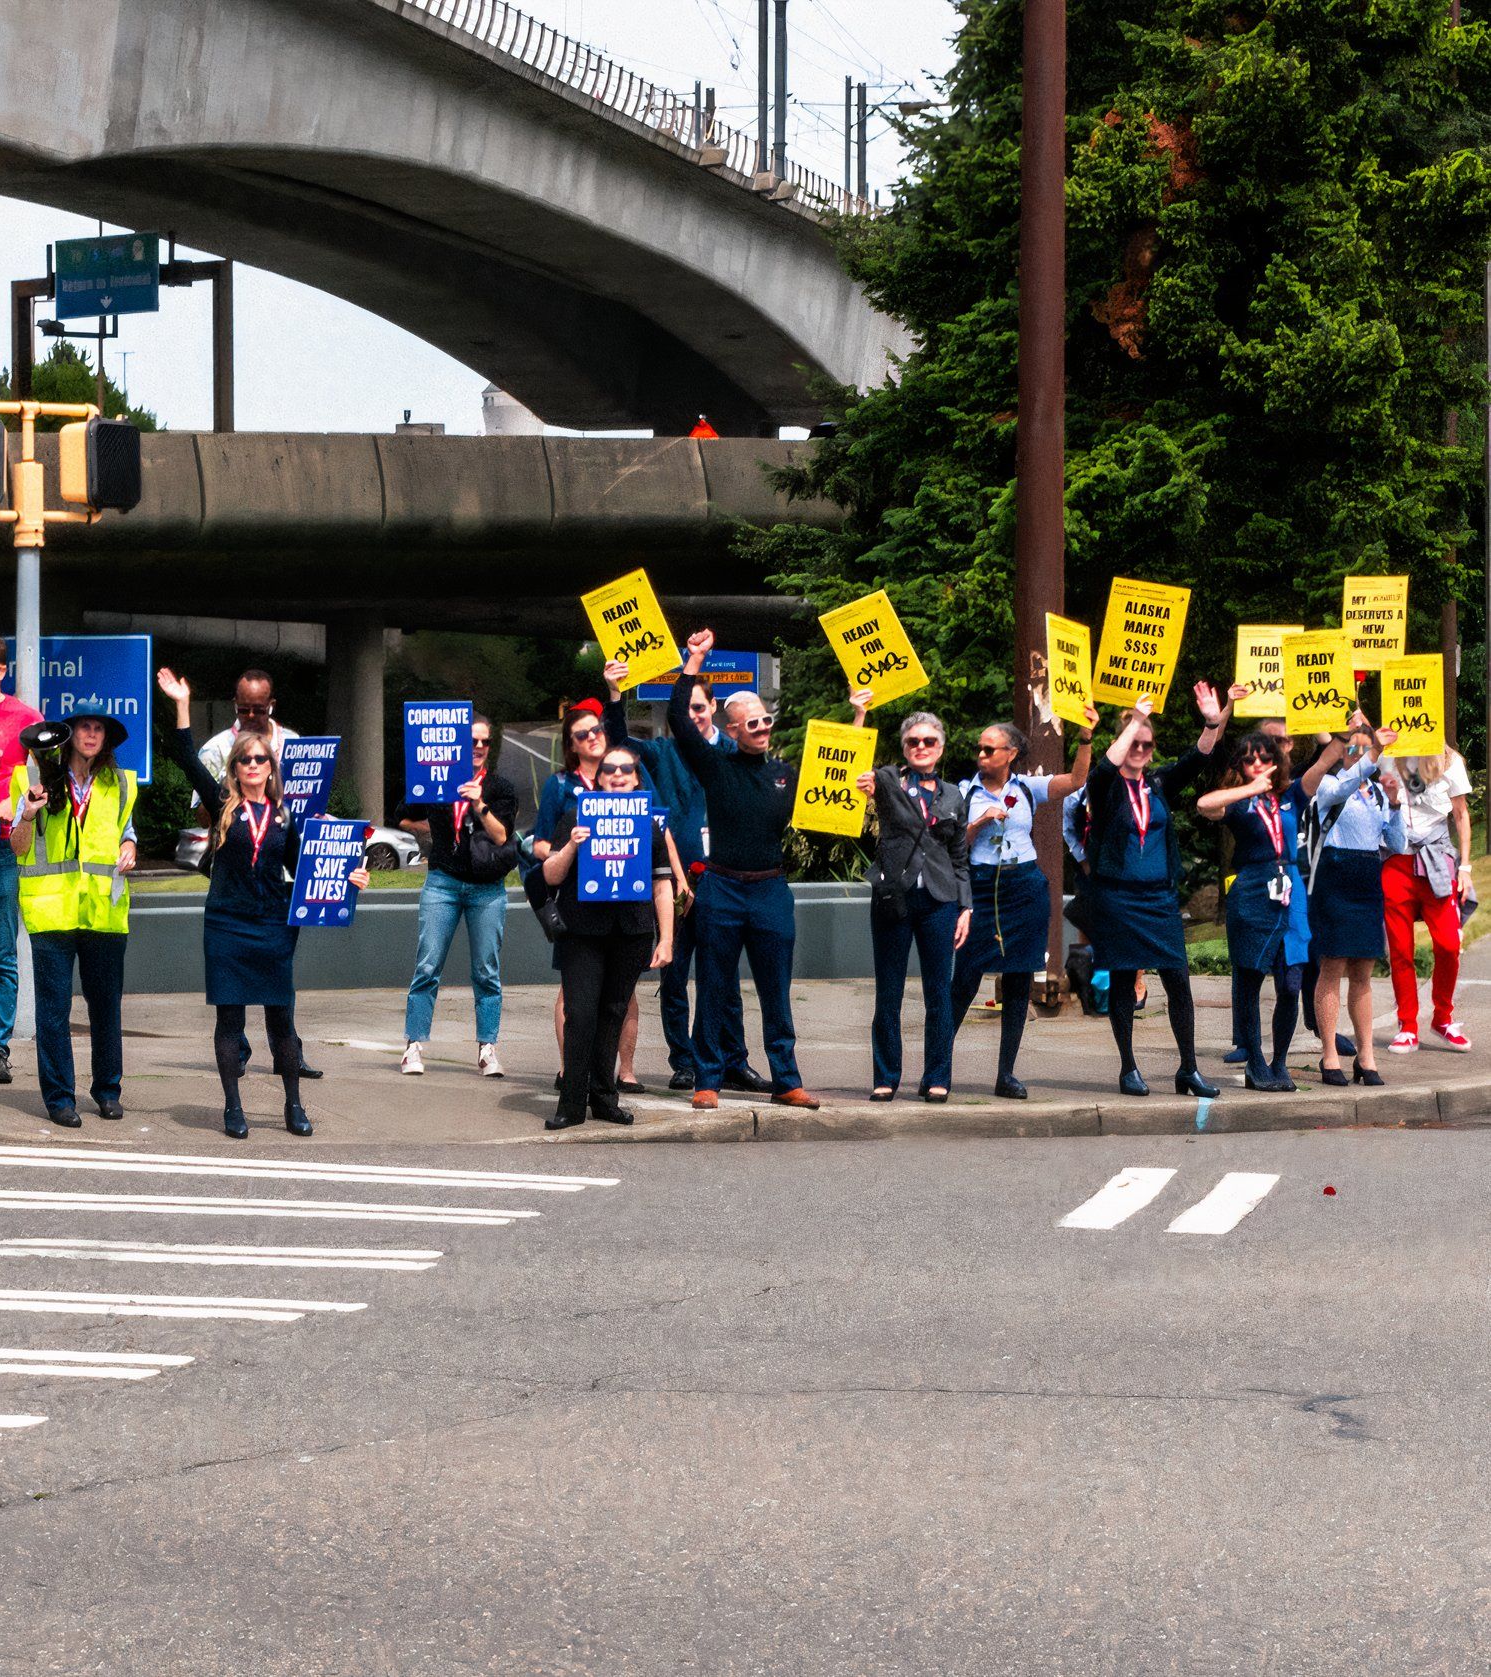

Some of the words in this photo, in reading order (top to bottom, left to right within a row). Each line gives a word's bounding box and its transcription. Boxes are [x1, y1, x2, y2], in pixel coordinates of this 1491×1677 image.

[1351, 596, 1366, 605] MY
[602, 597, 639, 624] READY
[1125, 601, 1170, 620] ALASKA
[1346, 610, 1393, 620] DESERVES
[1397, 610, 1403, 619] A
[618, 617, 642, 636] FOR
[842, 619, 880, 644] READY
[1124, 620, 1165, 638] MAKES
[1362, 624, 1385, 634] NEW
[614, 631, 665, 663] CHAOS
[860, 638, 884, 657] FOR
[1353, 638, 1399, 649] ONTRACT
[857, 652, 909, 685] CHAOS
[1109, 655, 1128, 670] WE
[1131, 659, 1165, 676] CAN'T
[1259, 662, 1280, 673] FOR
[1296, 653, 1335, 667] READY
[1100, 672, 1134, 690] MAKE
[1137, 680, 1166, 695] RENT
[1308, 671, 1330, 684] FOR
[1393, 678, 1427, 690] READY
[1292, 688, 1348, 710] CHAOS
[1403, 696, 1422, 708] FOR
[408, 708, 469, 725] CORPORATE
[1389, 713, 1437, 732] CHAOS
[421, 727, 456, 743] GREED
[284, 743, 337, 760] CORPORATE
[416, 745, 462, 762] DOESN'T
[818, 746, 856, 764] READY
[292, 762, 322, 777] GREED
[430, 765, 449, 781] FLY
[825, 767, 847, 782] FOR
[284, 779, 323, 794] DOESN'T
[291, 799, 308, 813] FLY
[804, 785, 859, 811] CHAOS
[582, 798, 648, 816] CORPORATE
[319, 824, 353, 840] FLIGHT
[596, 818, 634, 835] GREED
[303, 840, 363, 857] ATTENDANTS
[591, 838, 640, 855] DOESN'T
[313, 857, 348, 878] SAVE
[605, 860, 625, 877] FLY
[305, 879, 348, 900] LIVES!
